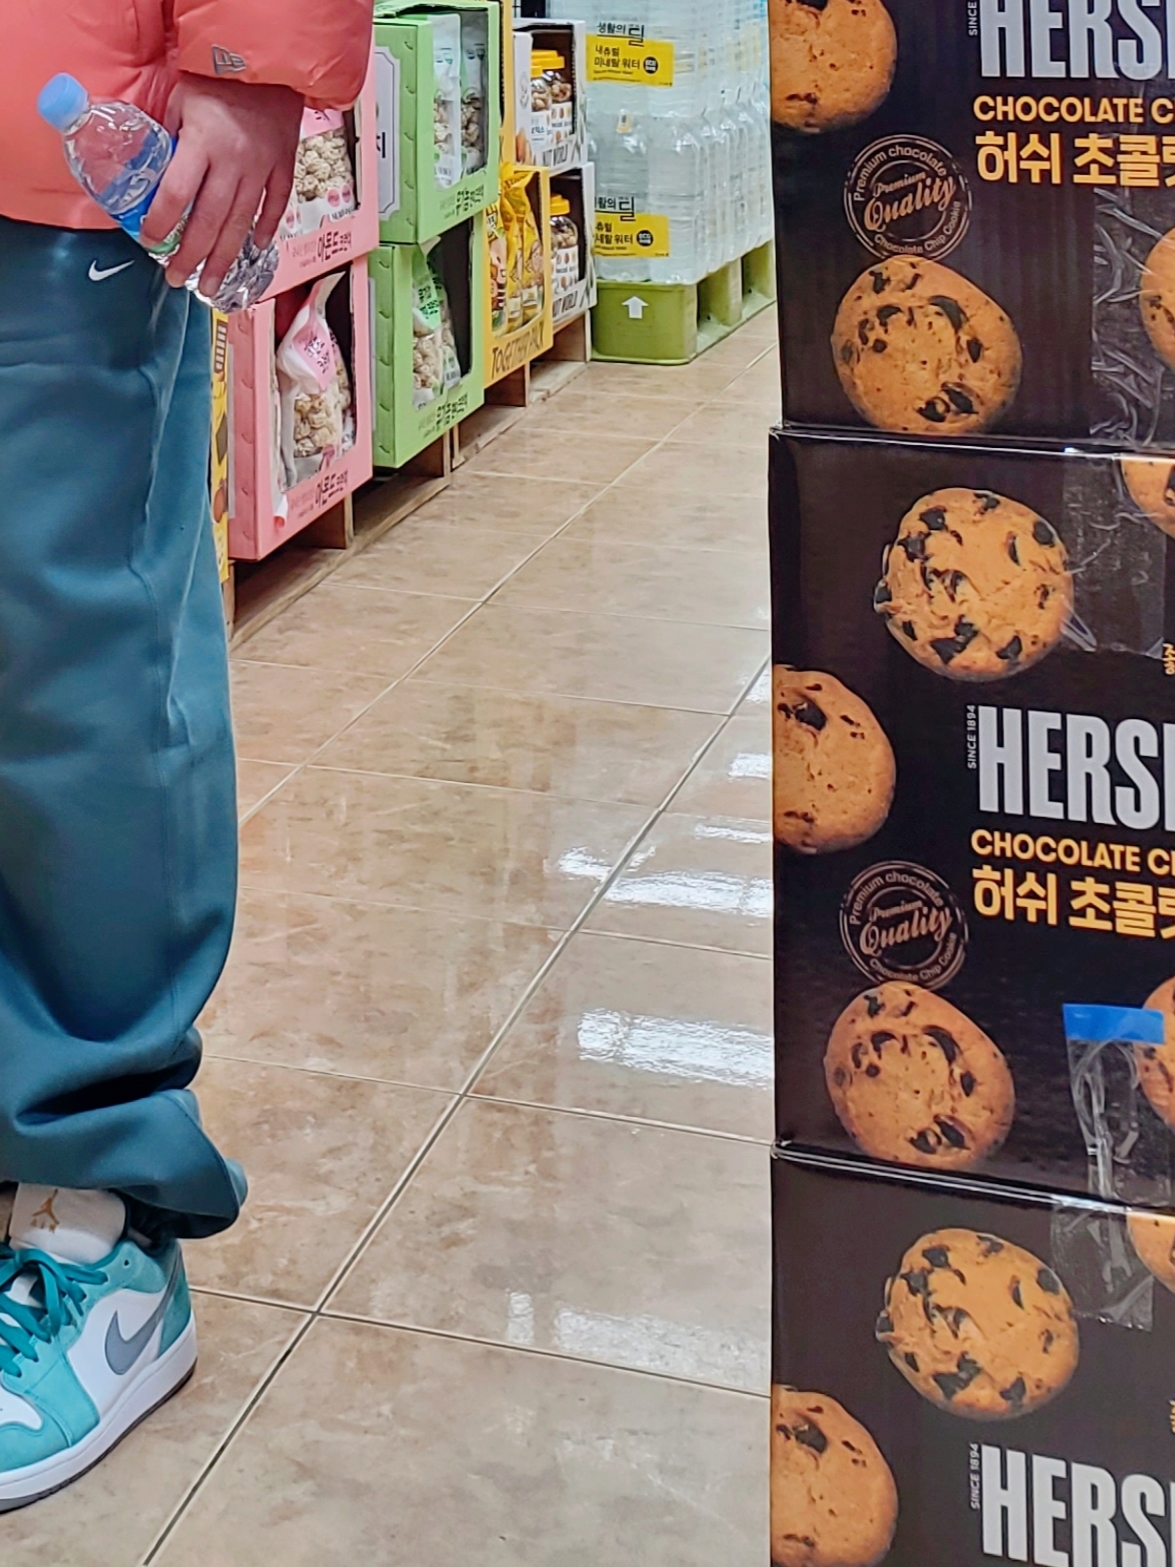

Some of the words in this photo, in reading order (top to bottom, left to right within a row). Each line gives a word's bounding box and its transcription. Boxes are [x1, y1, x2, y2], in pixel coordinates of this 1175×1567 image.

[596, 22, 627, 35] 생활의
[967, 2, 979, 37] SINCE
[622, 58, 641, 70] 워터
[973, 95, 1145, 124] CHOCOLATE
[852, 151, 888, 202] Premium
[887, 144, 948, 177] chocolate
[975, 131, 1062, 185] 허쉬
[864, 175, 957, 233] Quality
[614, 234, 634, 245] 워터
[873, 233, 924, 255] Chocolate
[923, 234, 946, 252] Chip
[942, 200, 962, 235] Cookie
[966, 703, 977, 733] 1894
[967, 733, 978, 770] SINCE
[970, 828, 1141, 873] CHOCOLATE
[848, 875, 885, 926] Premium
[885, 869, 945, 908] chocolate
[972, 863, 1058, 926] 허쉬
[859, 906, 954, 958] Quality
[919, 963, 943, 981] Chip
[970, 1442, 980, 1473] 1894
[970, 1474, 981, 1510] SINCE
[980, 1442, 1175, 1567] HERS
